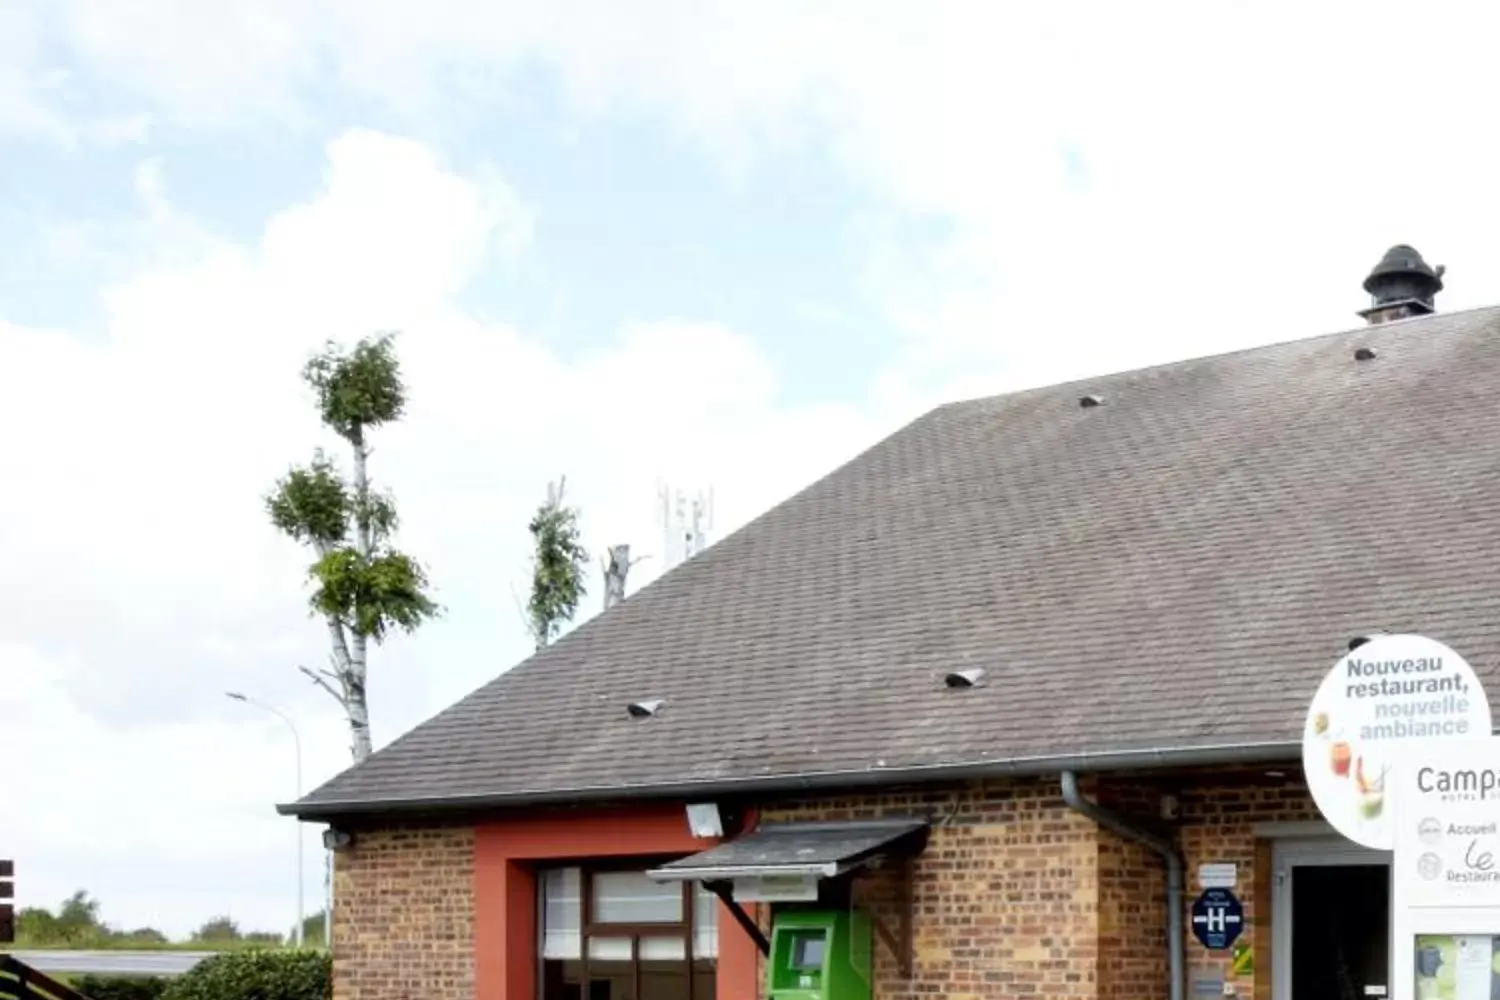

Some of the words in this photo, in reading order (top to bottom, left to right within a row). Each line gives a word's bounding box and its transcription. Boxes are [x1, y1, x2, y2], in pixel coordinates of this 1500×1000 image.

[1347, 656, 1443, 678] Nouveau
[1346, 672, 1469, 698] restaurant,
[1374, 696, 1470, 718] nouvelle
[1359, 717, 1469, 740] ambiance
[1446, 822, 1497, 835] Accueil
